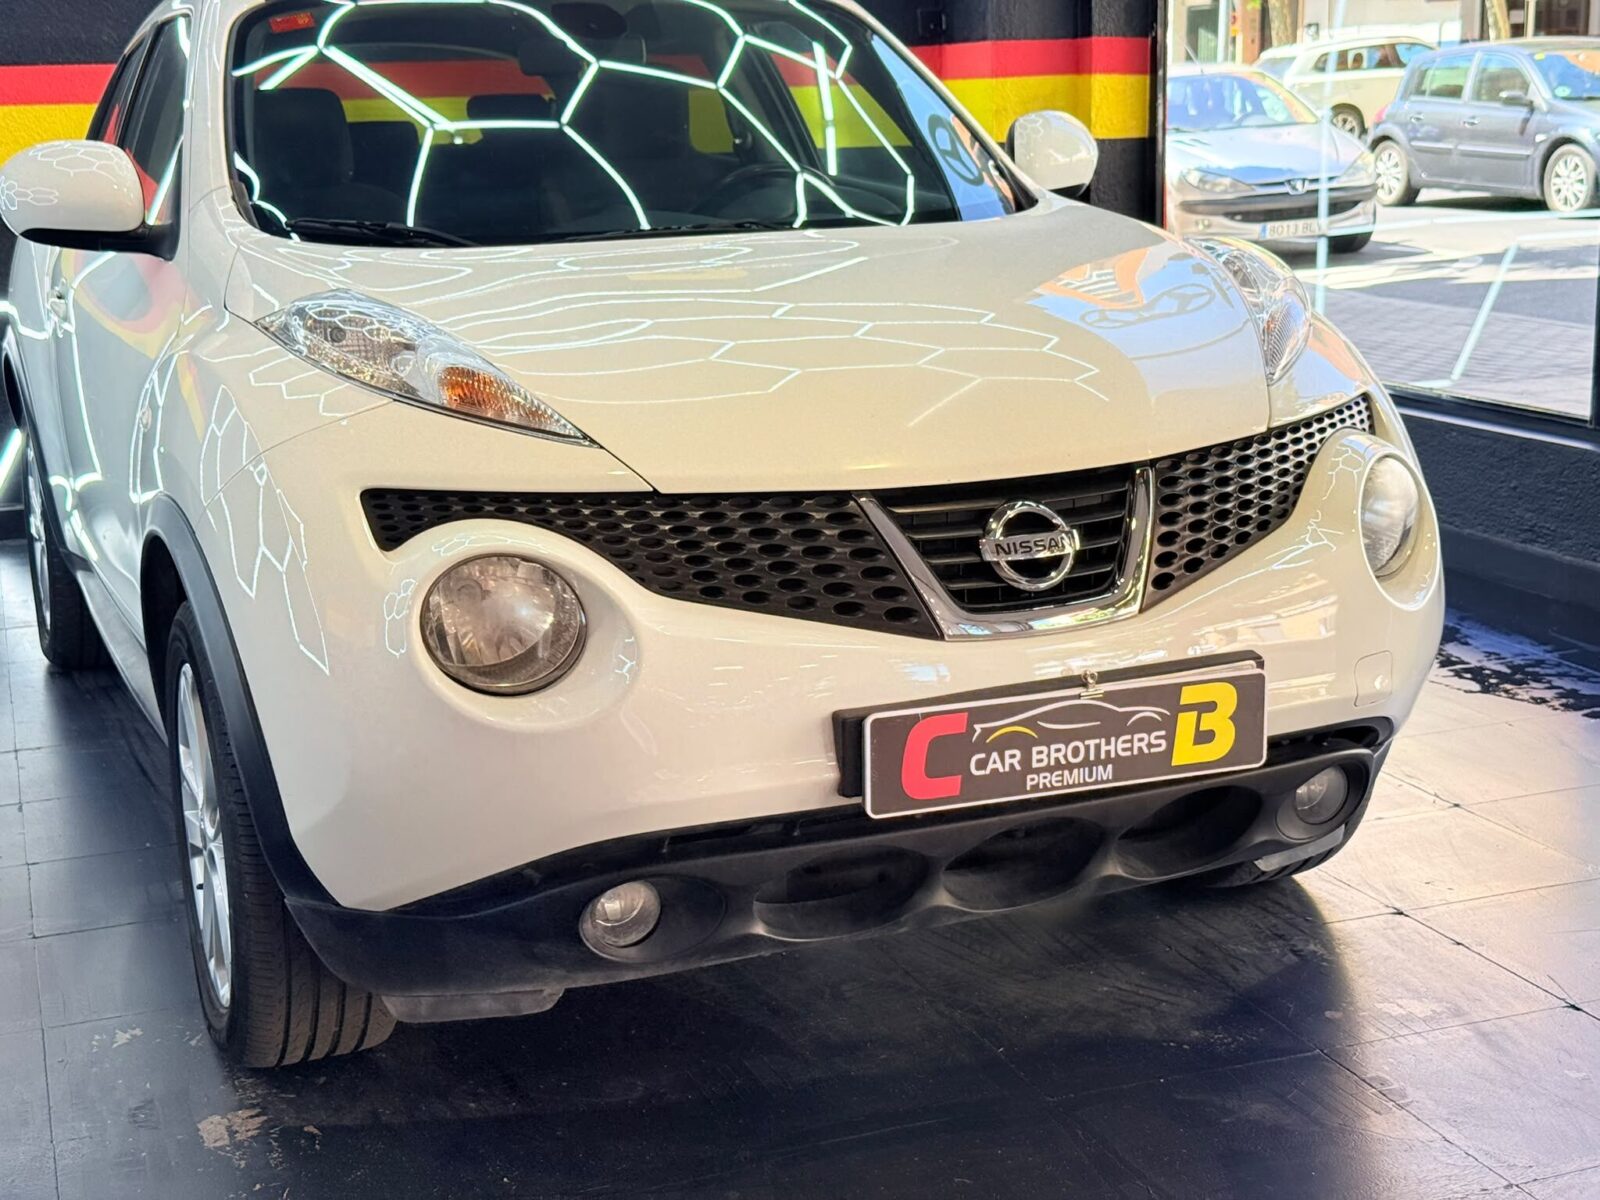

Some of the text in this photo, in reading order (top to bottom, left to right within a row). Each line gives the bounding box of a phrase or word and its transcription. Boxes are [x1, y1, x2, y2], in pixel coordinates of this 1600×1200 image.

[1269, 224, 1298, 236] 8013
[995, 532, 1073, 556] NISSAN
[1172, 682, 1238, 767] B
[902, 713, 968, 800] C
[970, 730, 1167, 777] CAR BROTHERS
[1025, 764, 1113, 792] PREMIUM
